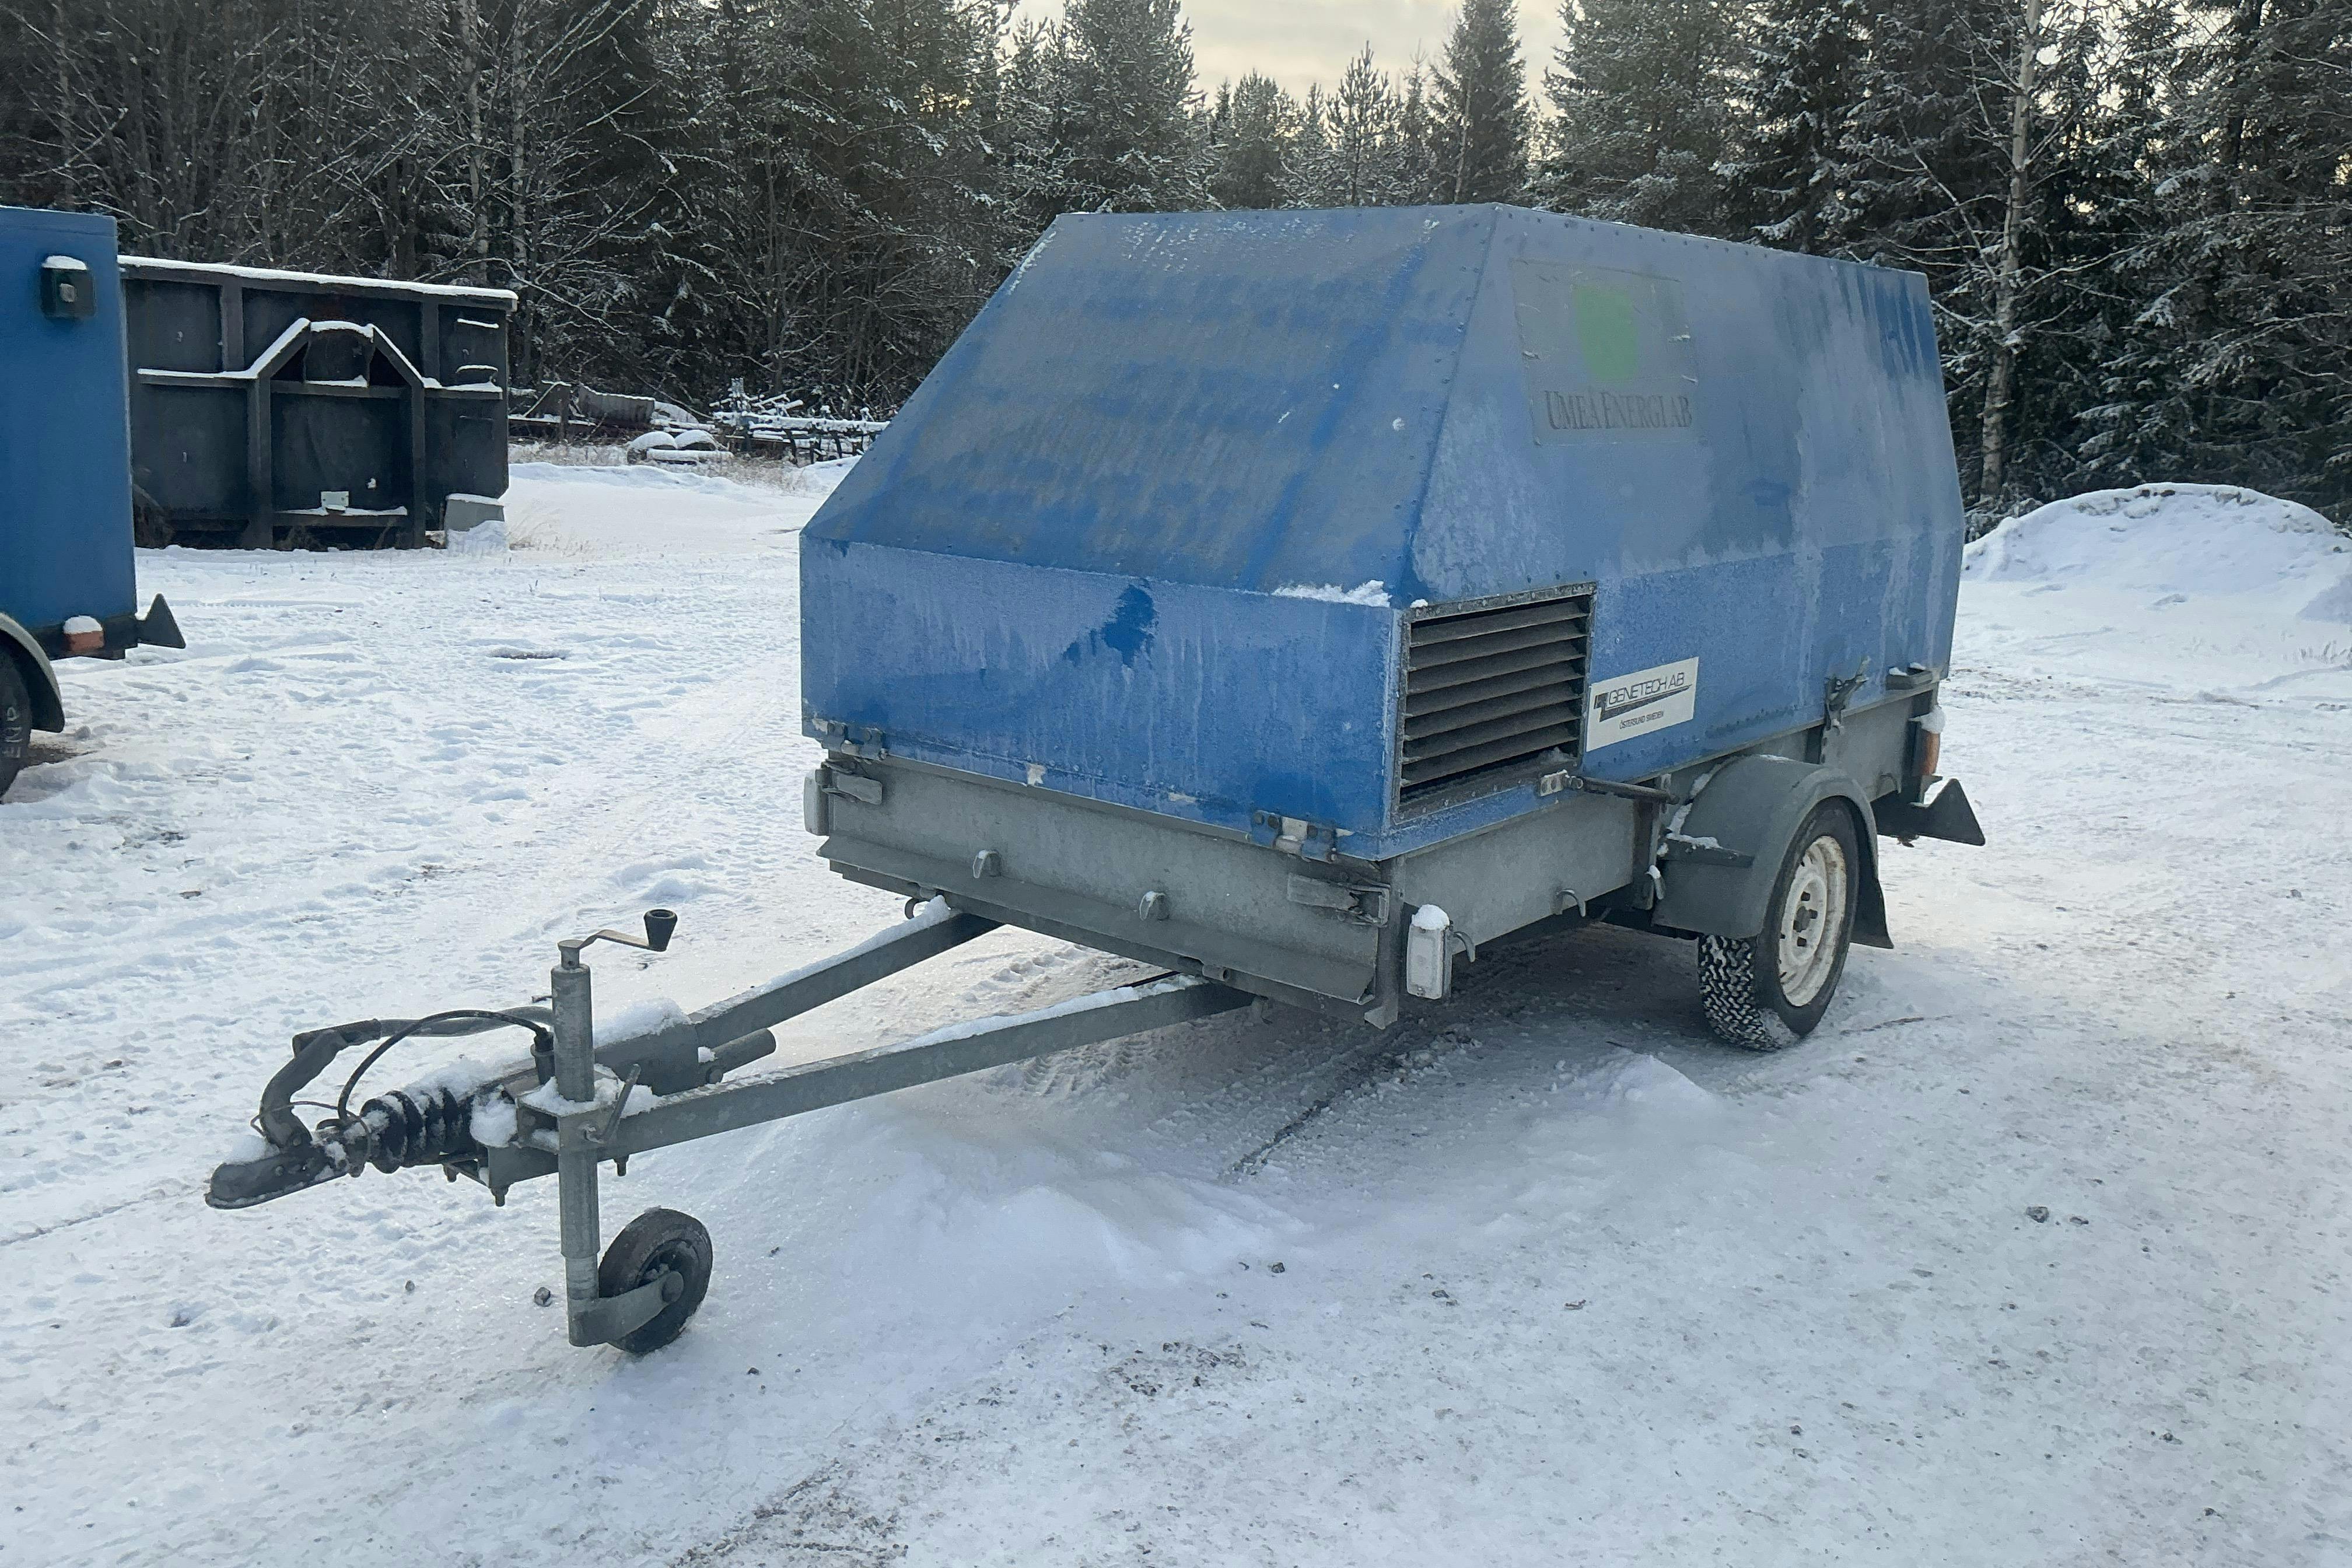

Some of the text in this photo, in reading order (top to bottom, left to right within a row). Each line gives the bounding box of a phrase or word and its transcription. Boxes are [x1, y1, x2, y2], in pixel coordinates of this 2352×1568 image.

[1668, 396, 1693, 428] AB
[1609, 671, 1685, 705] GENETECH AB
